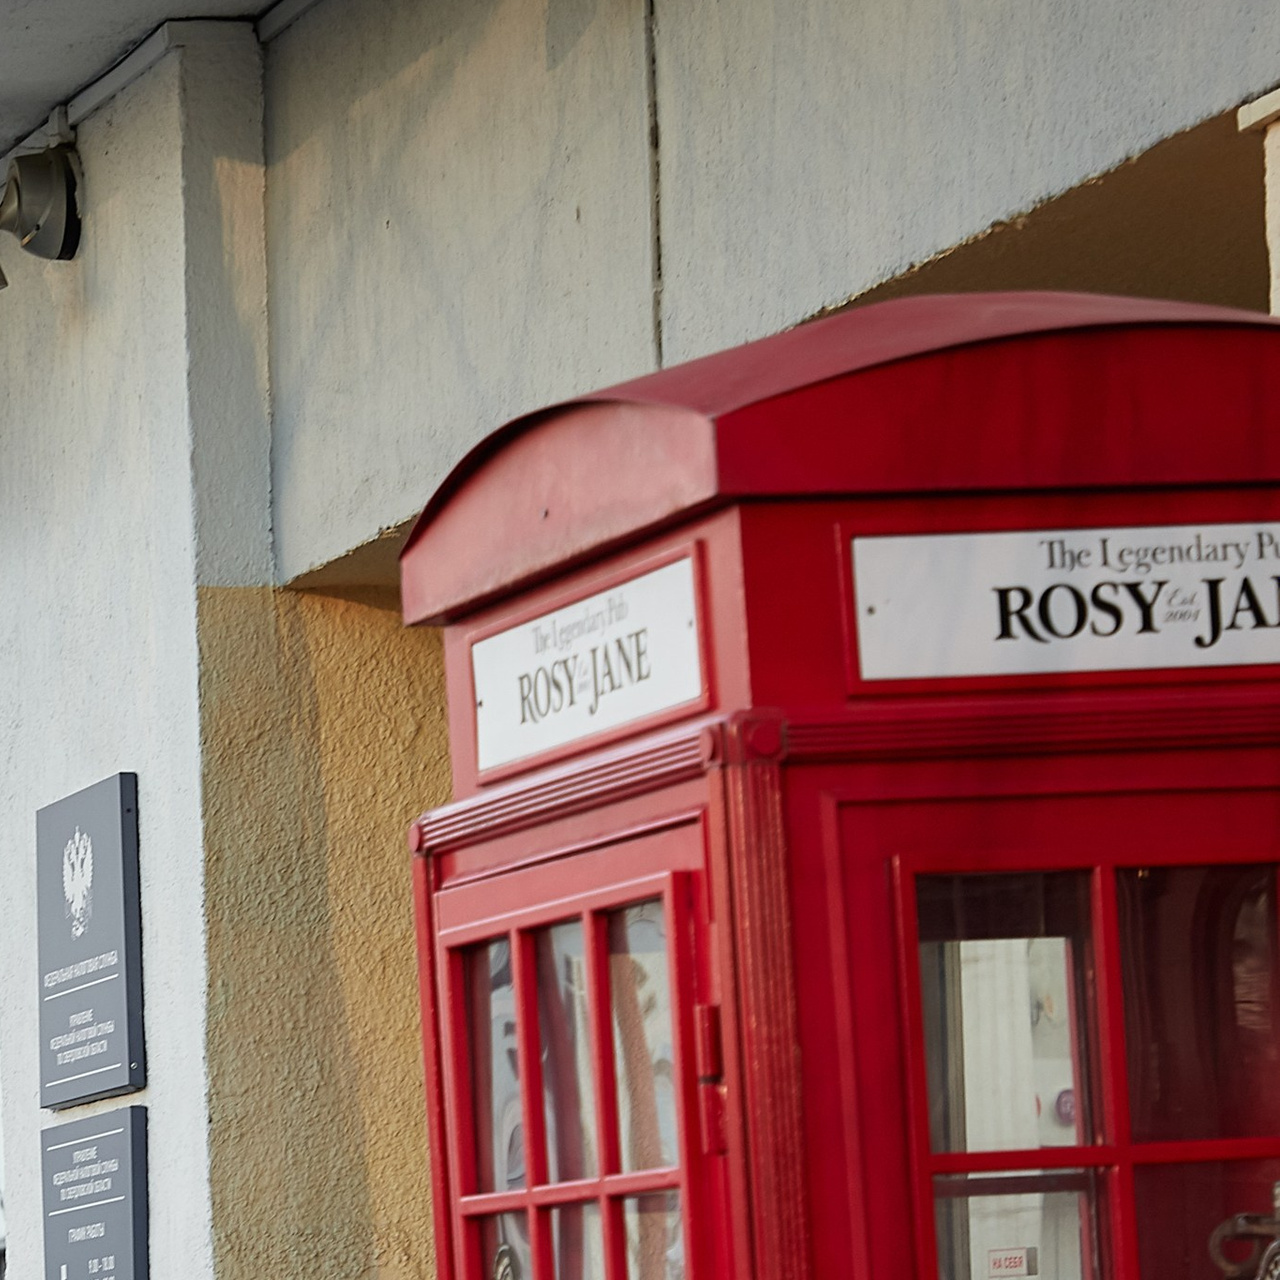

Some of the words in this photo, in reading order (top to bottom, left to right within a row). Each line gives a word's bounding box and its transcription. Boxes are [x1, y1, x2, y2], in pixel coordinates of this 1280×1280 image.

[1039, 538, 1091, 572] The
[1099, 533, 1250, 574] Legendary
[992, 579, 1170, 645] ROSY
[518, 654, 578, 725] ROSY
[588, 627, 651, 716] JANE
